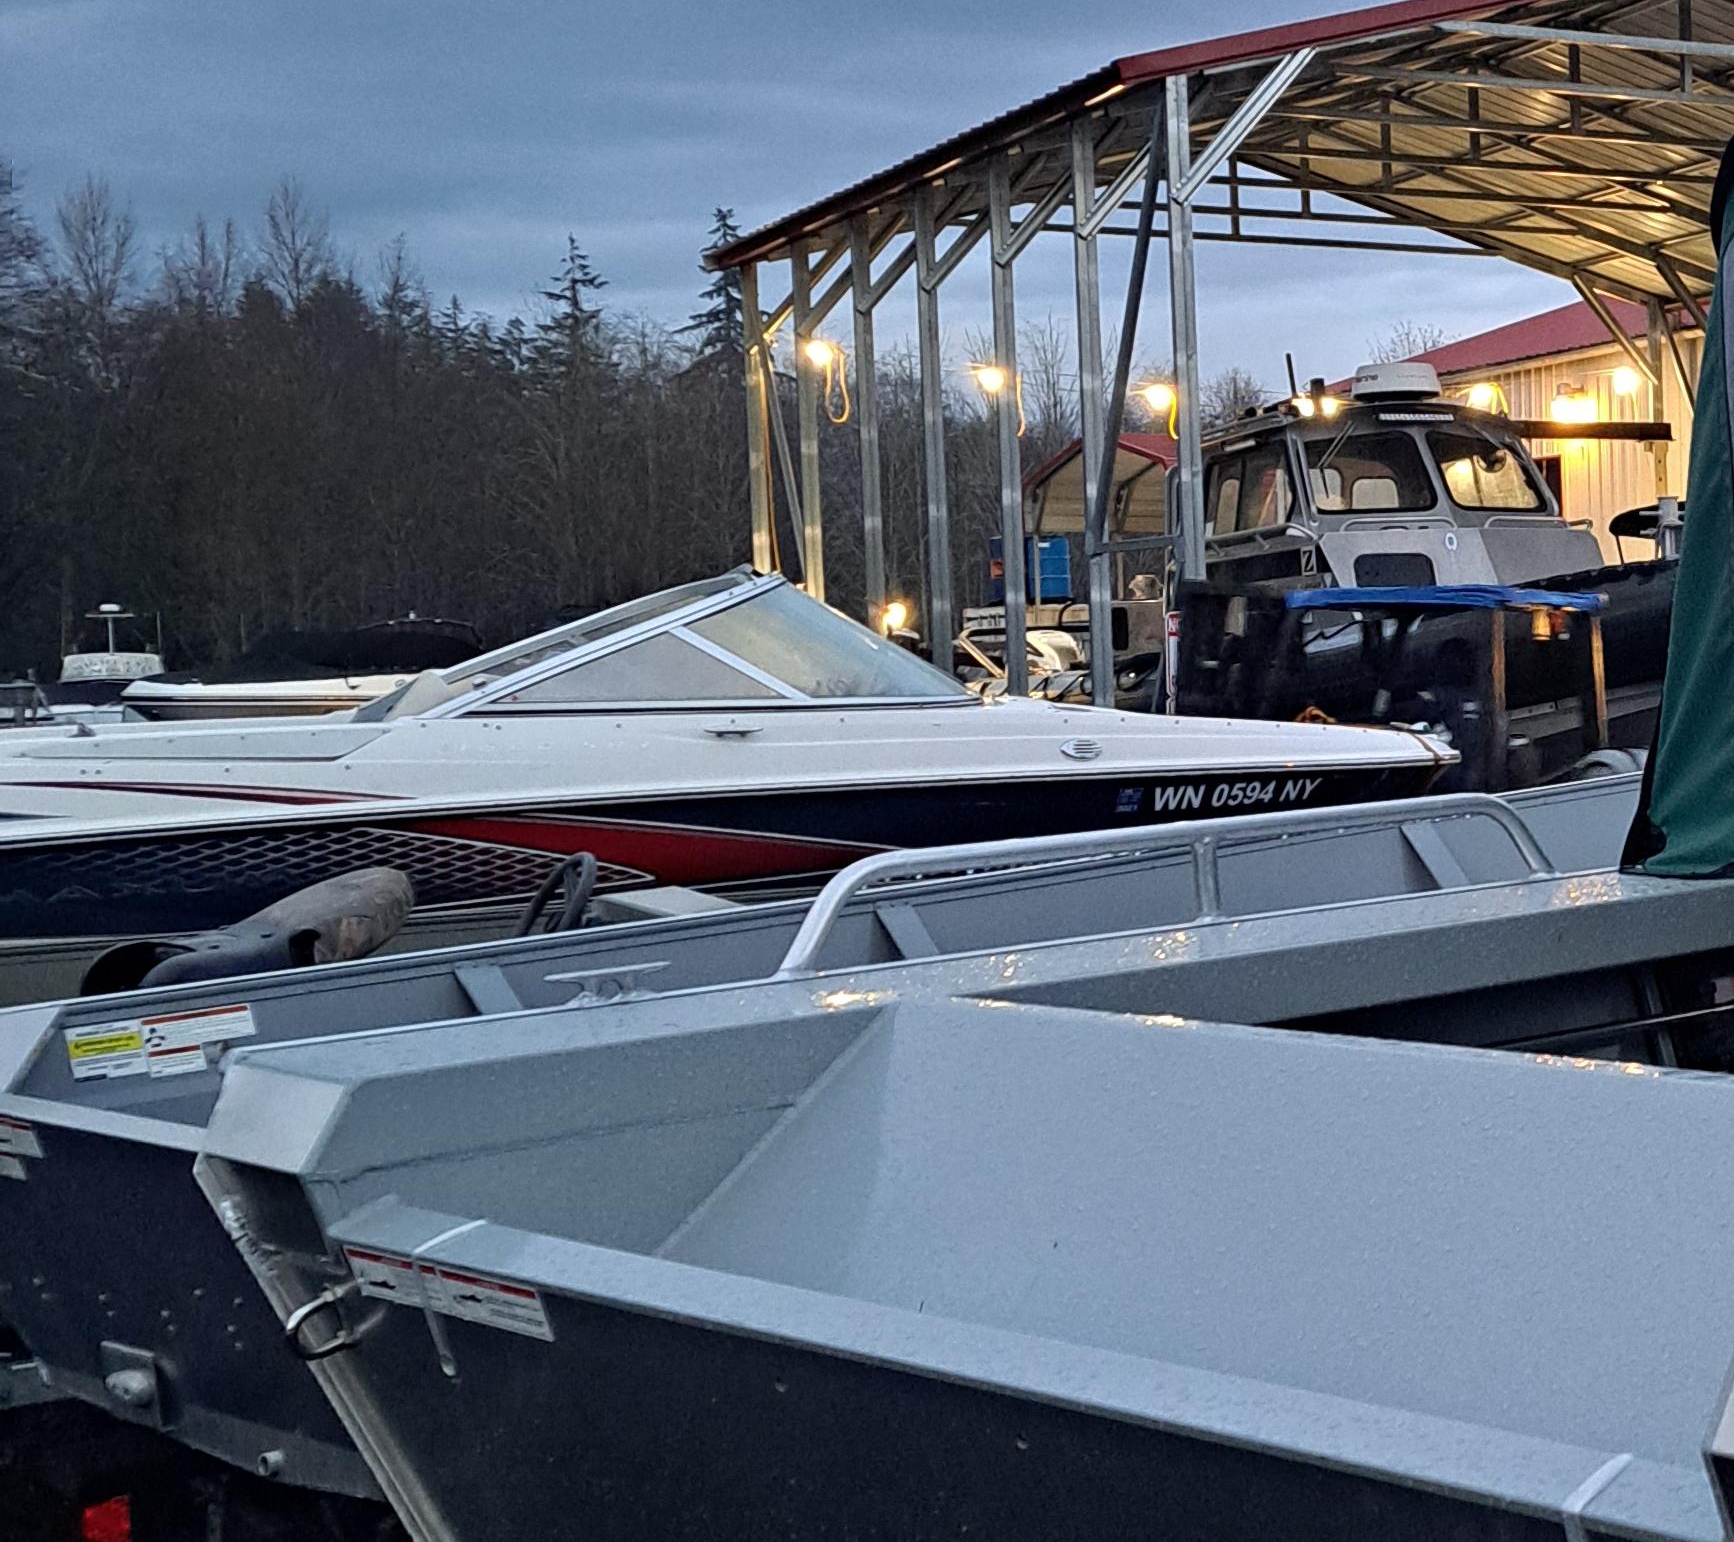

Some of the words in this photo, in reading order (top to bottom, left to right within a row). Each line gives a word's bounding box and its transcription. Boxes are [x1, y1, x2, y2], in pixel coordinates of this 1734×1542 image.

[1154, 785, 1206, 811] WN
[1211, 780, 1277, 807] 0594
[1279, 777, 1323, 803] NY
